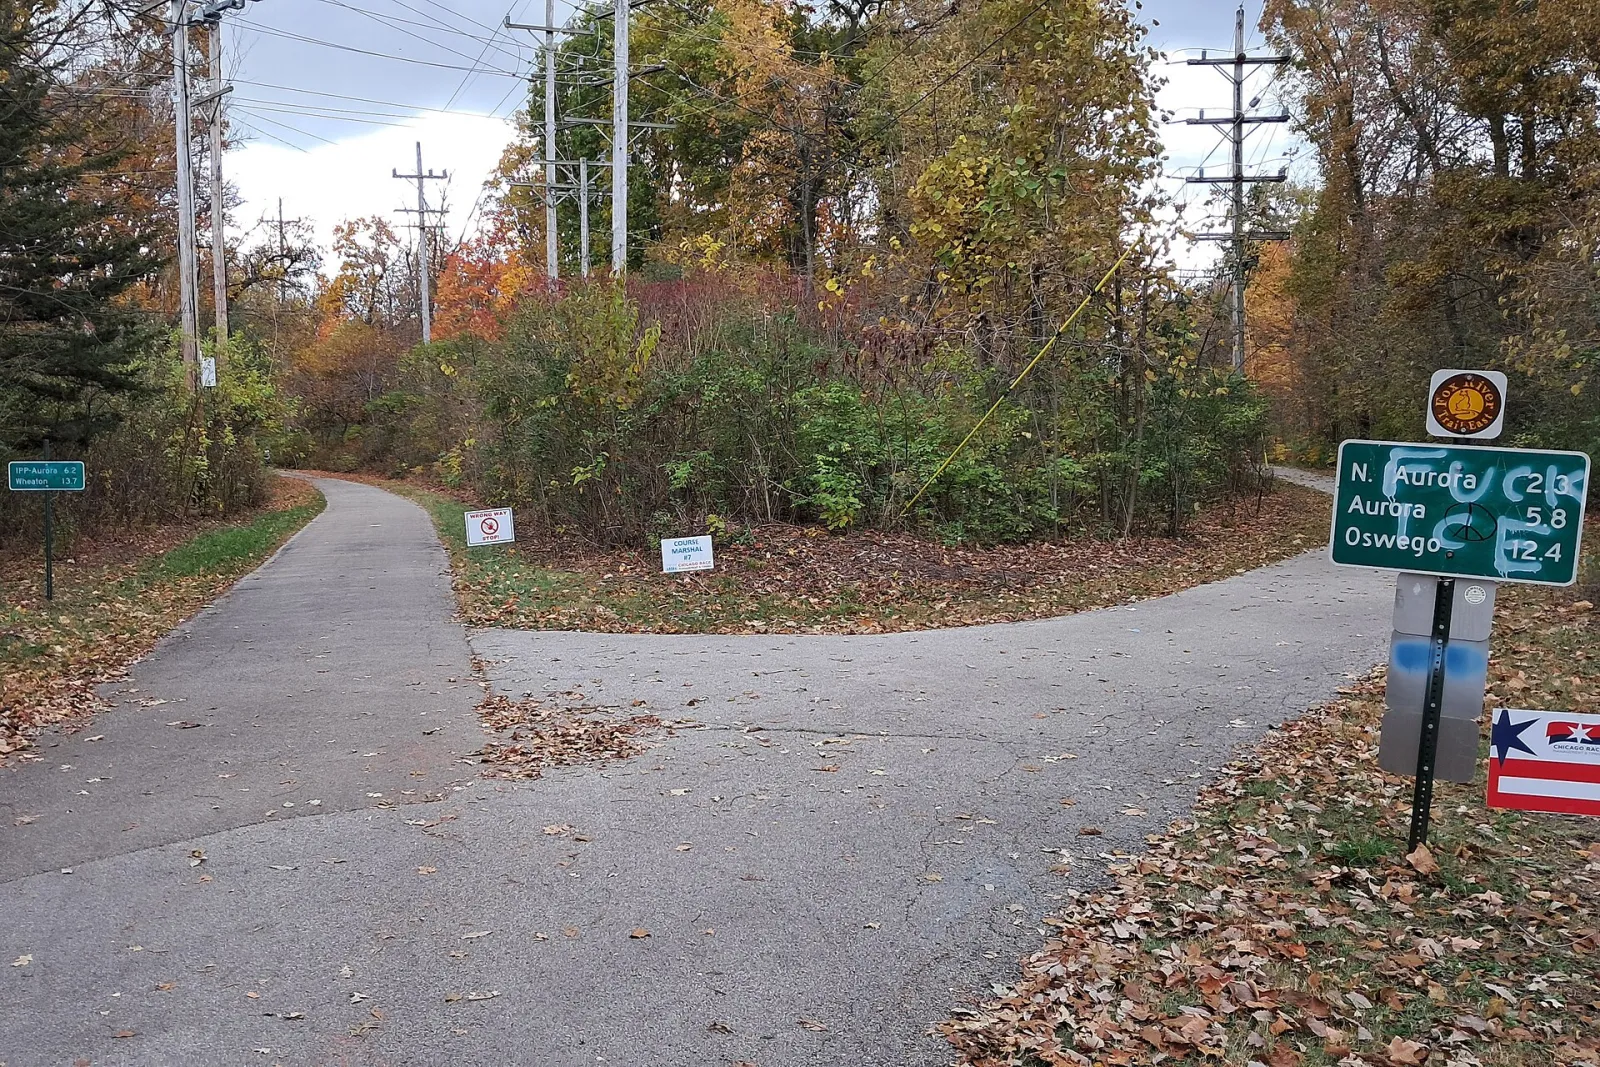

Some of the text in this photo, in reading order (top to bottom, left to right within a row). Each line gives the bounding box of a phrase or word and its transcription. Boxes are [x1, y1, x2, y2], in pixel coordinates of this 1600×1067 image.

[1435, 380, 1494, 409] Fox River
[1438, 410, 1493, 430] Trail East
[1351, 462, 1569, 495] N. Aurora 2.3
[1382, 448, 1585, 509] FUCK
[1347, 495, 1567, 530] Aurora 5.8
[1345, 526, 1562, 563] Oswego 12.4
